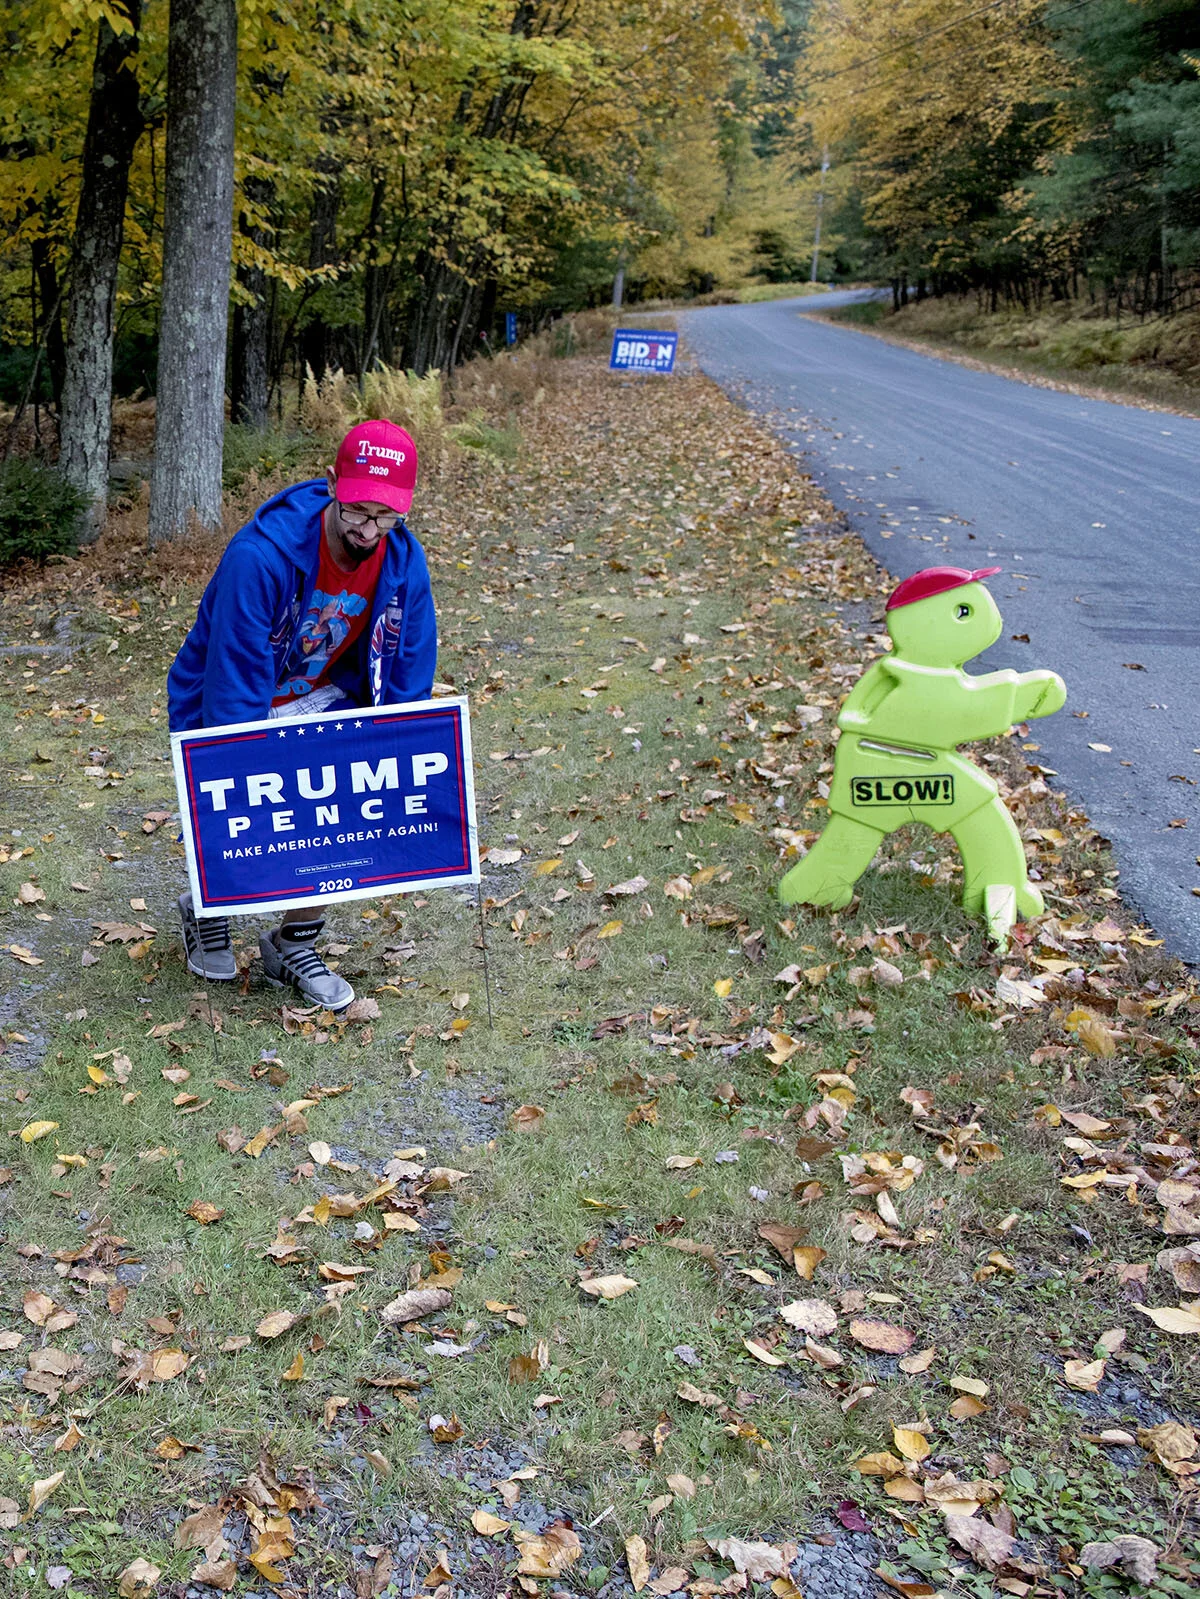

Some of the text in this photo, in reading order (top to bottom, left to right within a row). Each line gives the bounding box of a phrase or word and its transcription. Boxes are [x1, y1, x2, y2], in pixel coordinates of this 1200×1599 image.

[616, 340, 673, 360] BIDEN
[614, 357, 670, 368] PRESIDENT
[358, 440, 406, 467] Trump
[368, 465, 389, 476] 2020
[199, 752, 449, 812] TRUMP
[855, 780, 950, 801] SLOW!
[228, 794, 428, 839] PENCE
[223, 822, 439, 860] MAKE AMERICA GREAT AGAIN!
[318, 877, 353, 893] 2020
[294, 929, 318, 937] adidas
